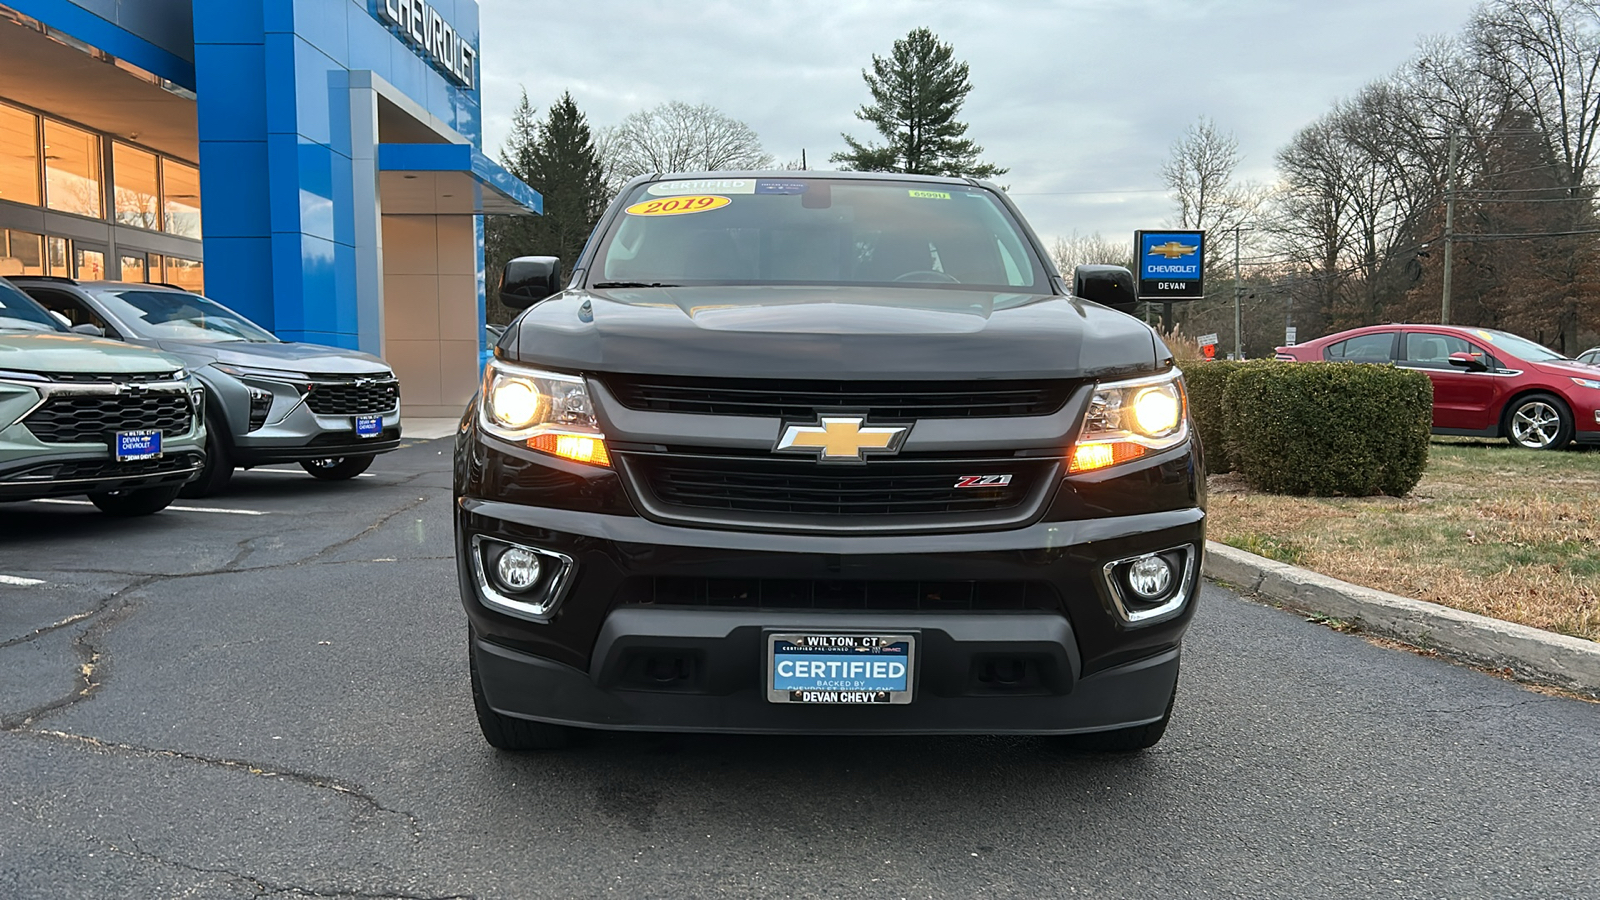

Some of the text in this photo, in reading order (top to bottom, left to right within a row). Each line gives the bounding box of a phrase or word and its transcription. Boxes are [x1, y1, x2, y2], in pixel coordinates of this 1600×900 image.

[643, 197, 715, 215] 2019
[1147, 265, 1197, 273] CHEVROLET
[1158, 282, 1186, 290] DEVAN
[953, 474, 1013, 488] Z71
[807, 636, 878, 647] WILTON, CT
[777, 660, 906, 679] CERTIFIED
[803, 691, 876, 703] DEVAN CHEVY
